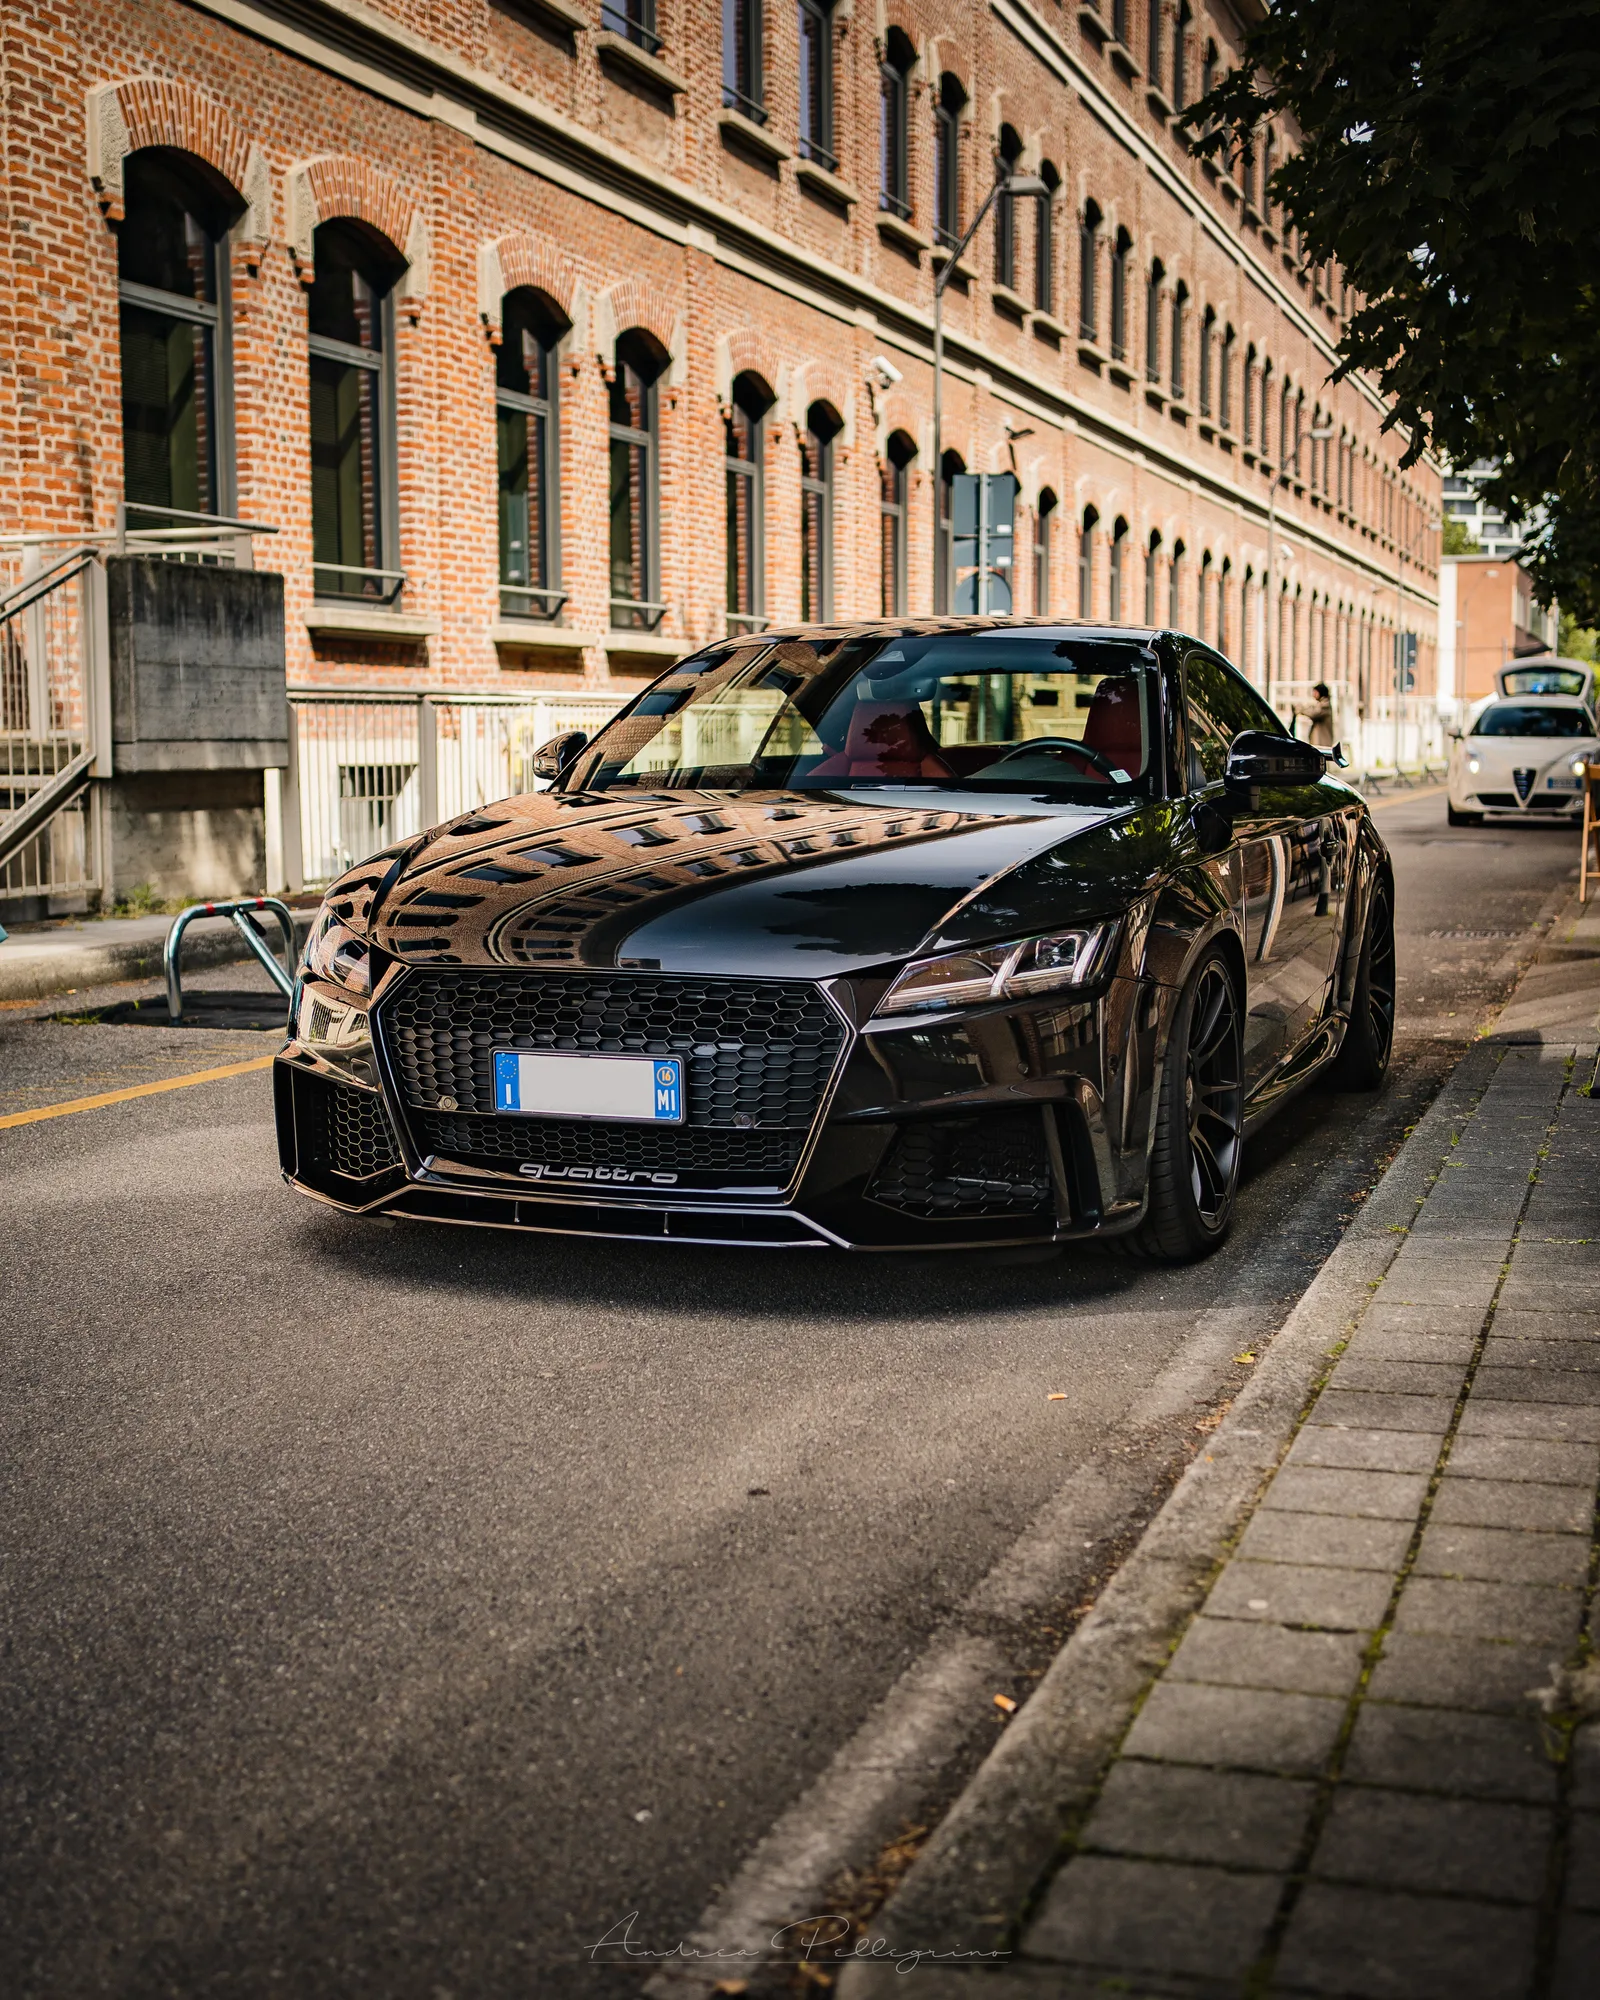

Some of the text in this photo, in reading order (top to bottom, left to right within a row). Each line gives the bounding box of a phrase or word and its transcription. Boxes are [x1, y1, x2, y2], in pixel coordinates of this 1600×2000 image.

[661, 1070, 671, 1082] 16
[505, 1083, 512, 1105] I
[657, 1089, 676, 1112] MI
[519, 1162, 679, 1184] quattro
